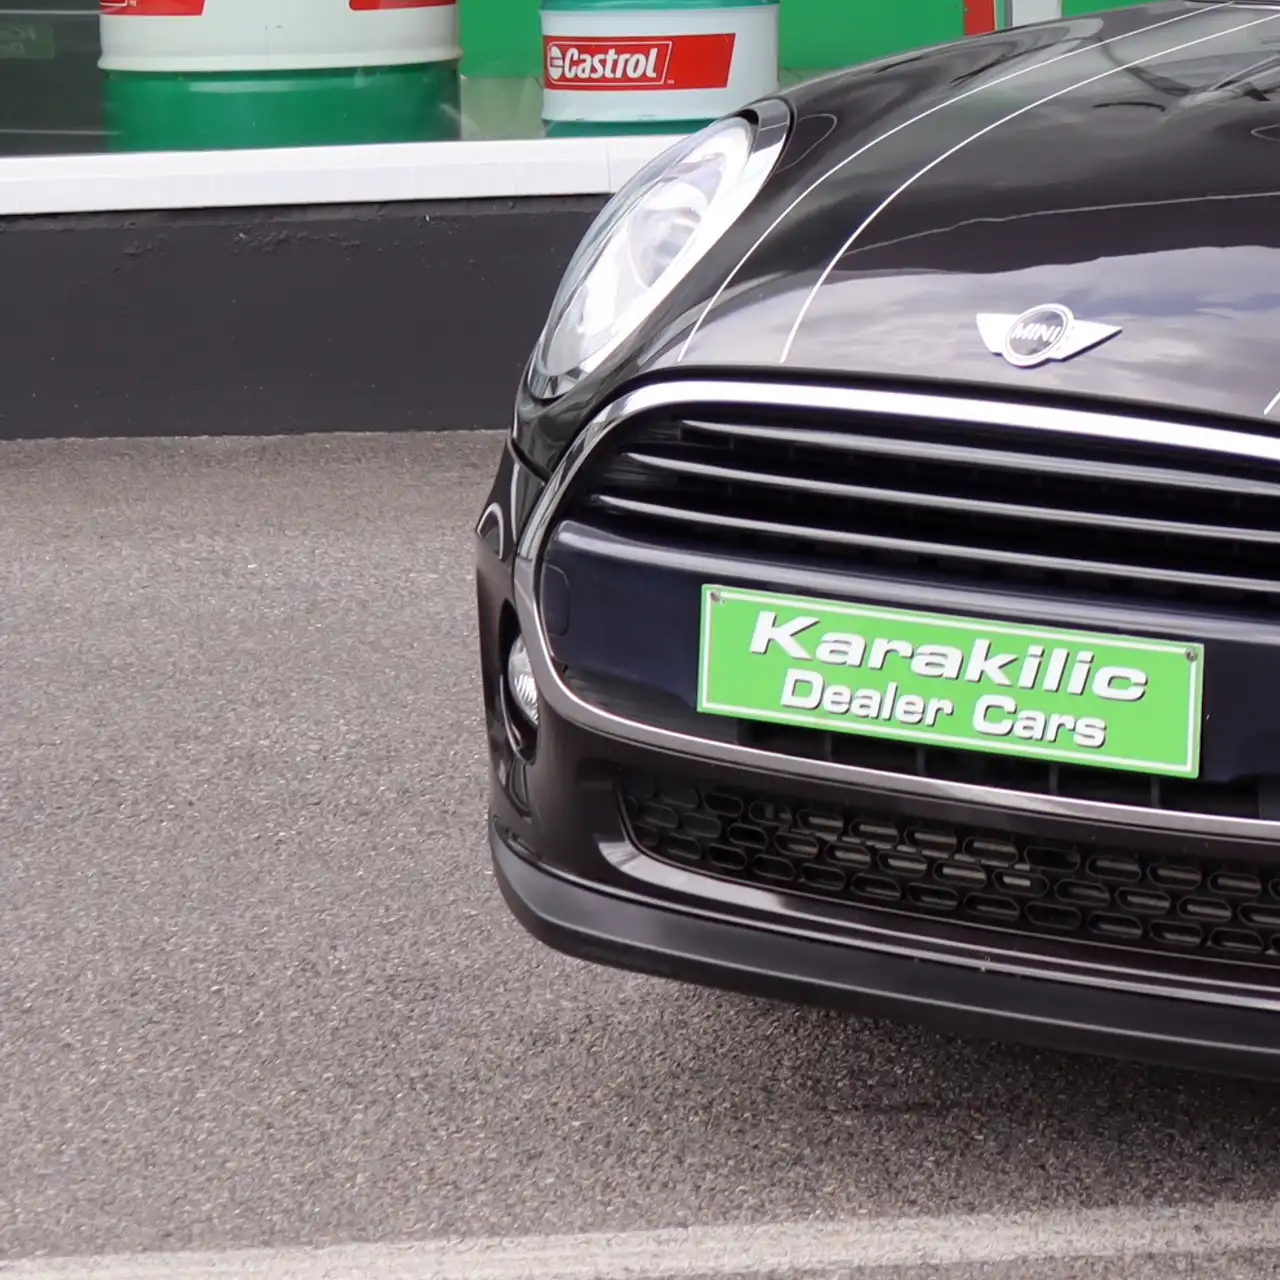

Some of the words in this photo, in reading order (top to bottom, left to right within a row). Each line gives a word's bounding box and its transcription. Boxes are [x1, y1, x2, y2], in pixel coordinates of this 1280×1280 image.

[562, 44, 659, 82] Castrol
[1011, 322, 1062, 343] MINI
[748, 609, 1150, 704] Karakilic
[779, 668, 953, 728] Dealer
[972, 693, 1108, 750] Cars
